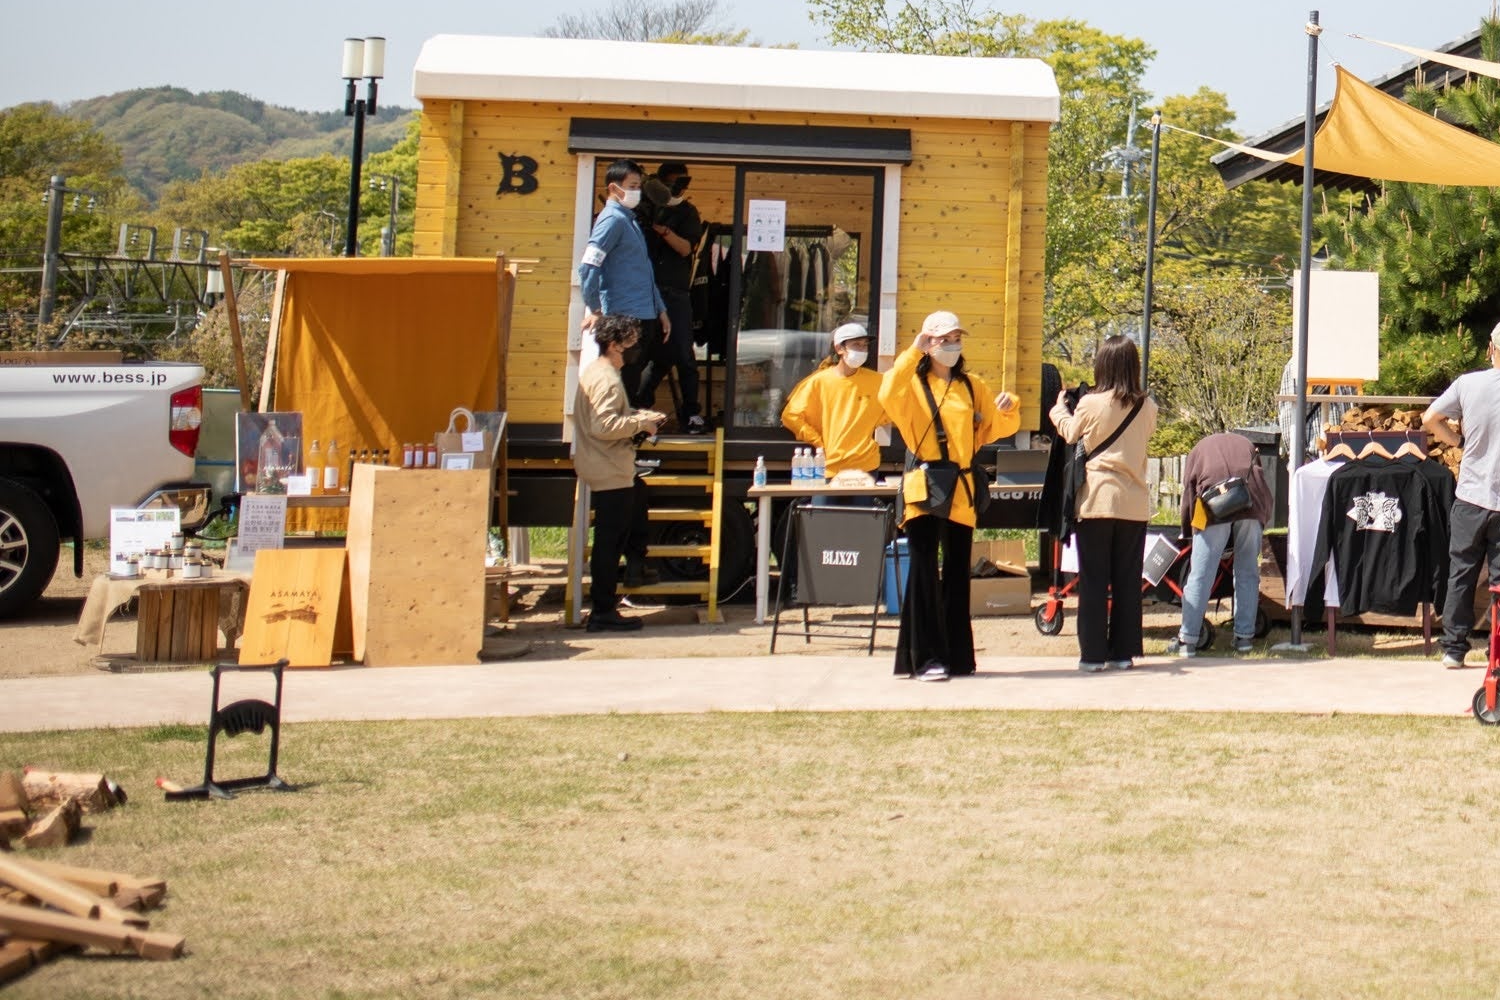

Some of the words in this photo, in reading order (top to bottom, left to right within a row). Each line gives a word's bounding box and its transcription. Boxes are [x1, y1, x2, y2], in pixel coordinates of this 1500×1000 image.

[496, 152, 539, 195] B
[52, 371, 167, 386] www.bess.jp
[822, 550, 859, 566] BLIXZY
[270, 590, 318, 598] ASAMAYA
